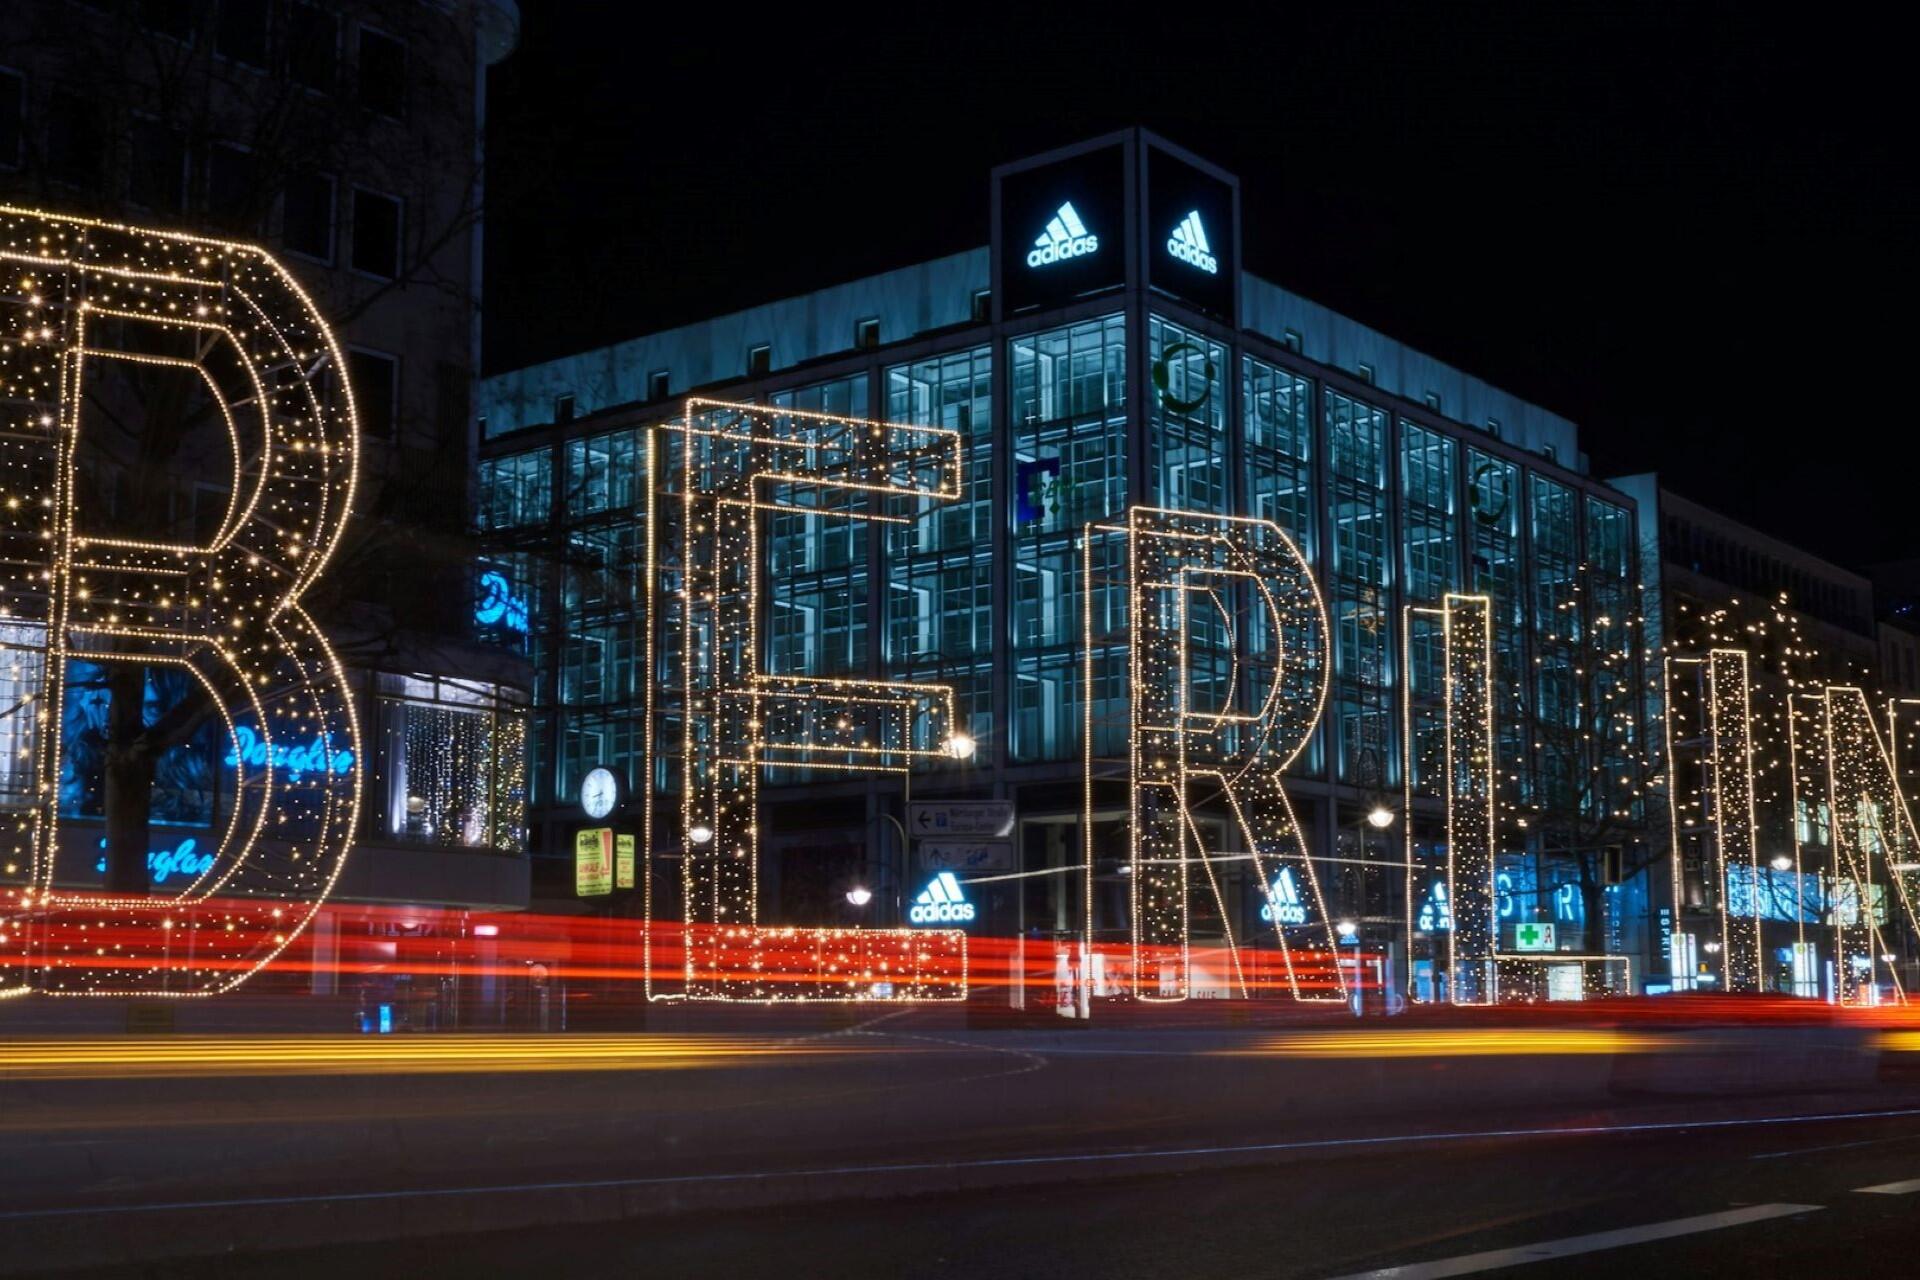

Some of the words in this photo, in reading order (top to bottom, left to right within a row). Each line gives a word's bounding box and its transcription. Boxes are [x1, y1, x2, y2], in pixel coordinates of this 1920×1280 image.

[1027, 235, 1098, 268] adidas
[1167, 238, 1218, 274] adidas
[224, 726, 354, 782] Douglas
[97, 838, 214, 882] glas
[910, 901, 976, 922] adidas
[1660, 908, 1671, 961] ESPRIT
